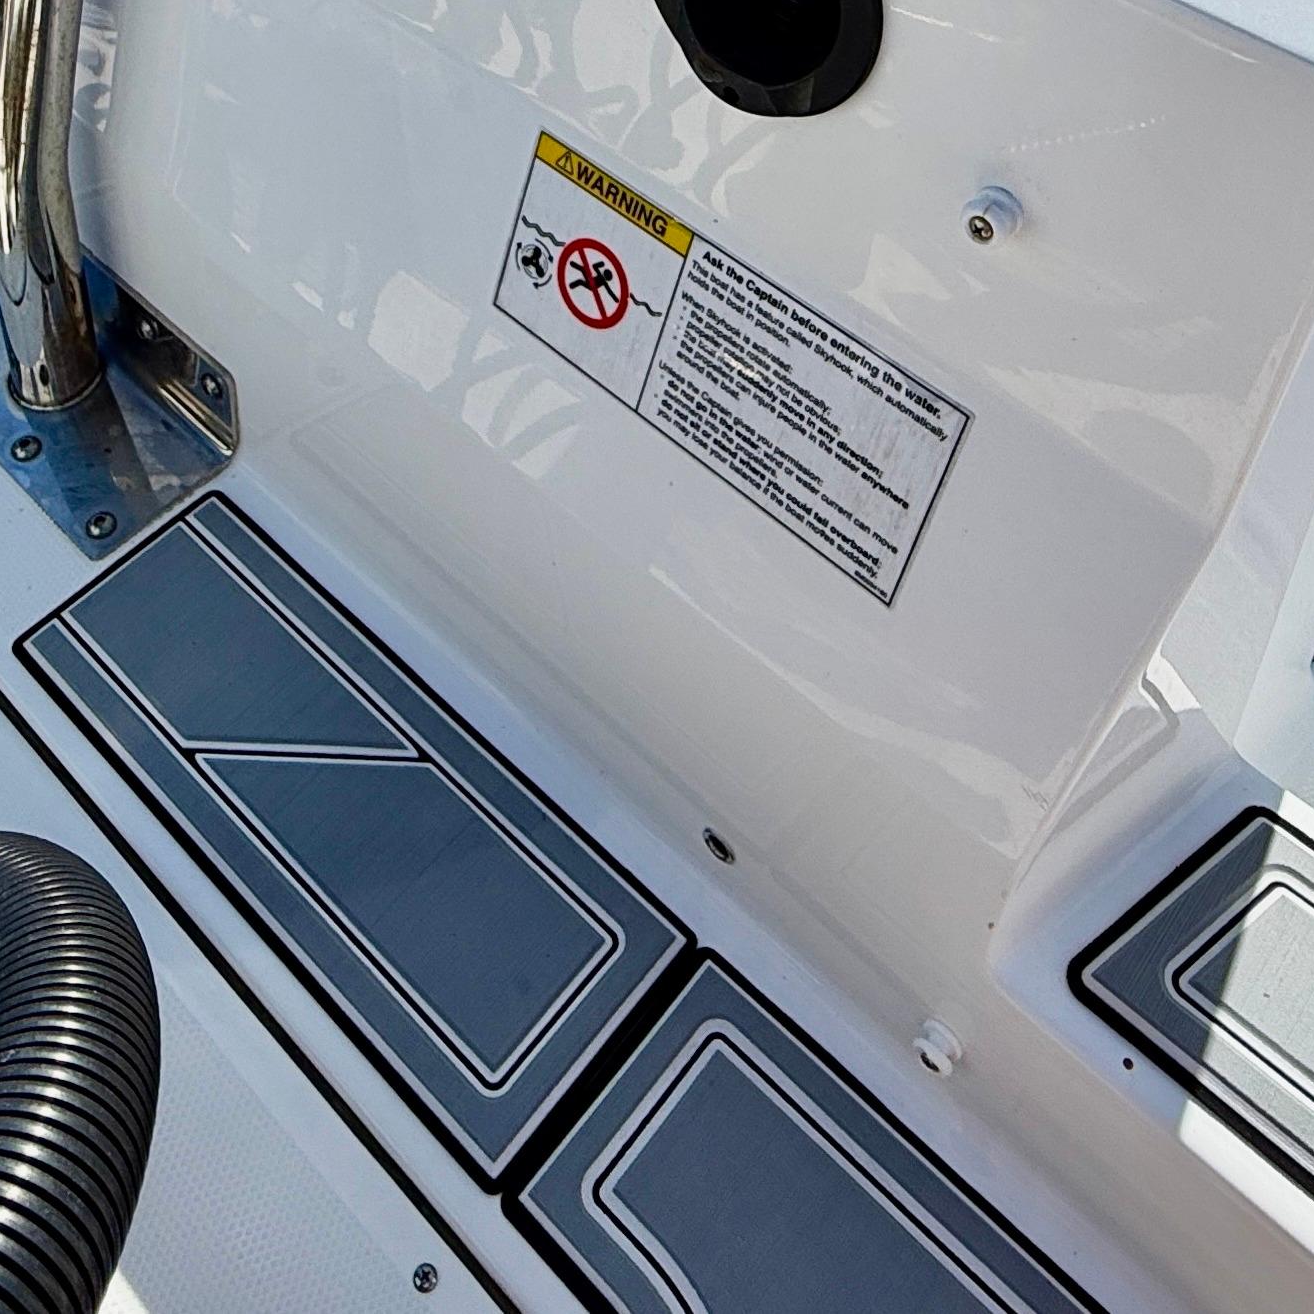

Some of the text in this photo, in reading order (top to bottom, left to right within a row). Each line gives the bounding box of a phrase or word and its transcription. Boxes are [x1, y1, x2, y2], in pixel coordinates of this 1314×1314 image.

[576, 160, 668, 237] WARNING
[681, 290, 705, 313] When
[705, 307, 741, 338] Skyhook
[742, 334, 750, 345] is
[686, 269, 710, 291] holds
[710, 286, 725, 301] the
[725, 296, 745, 315] boat
[745, 310, 754, 321] in
[701, 250, 940, 419] Ask the Captain before entering the water.
[675, 350, 705, 374] around
[705, 370, 719, 384] the
[685, 320, 722, 349] propeller
[775, 383, 790, 398] not
[790, 393, 803, 407] be
[690, 309, 704, 324] the
[703, 320, 745, 353] propellers
[745, 350, 771, 371] rotate
[692, 259, 709, 278] This
[709, 272, 729, 292] boat
[729, 285, 746, 303] has
[746, 299, 753, 308] a
[754, 302, 785, 329] feature
[785, 326, 813, 348] called
[856, 374, 884, 397] which
[884, 394, 948, 442] automatically
[658, 359, 685, 385] Unless
[686, 380, 700, 395] the
[700, 390, 732, 419] Captain
[732, 416, 756, 436] gives
[755, 433, 773, 449] you
[663, 389, 703, 422] swimmers
[703, 418, 720, 434] into
[720, 430, 734, 444] the
[679, 339, 909, 510] the propellers can injure people in the water anywhere
[736, 368, 778, 403] suddenly
[778, 399, 805, 421] move
[805, 416, 816, 429] in
[816, 426, 835, 444] any
[656, 407, 672, 422] you
[672, 419, 690, 437] may
[691, 432, 709, 450] lose
[708, 446, 728, 463] your
[728, 460, 762, 490] balance
[762, 486, 770, 495] if
[769, 491, 784, 507] the
[784, 502, 805, 523] boat
[805, 519, 835, 545] moves
[660, 398, 673, 411] do
[672, 407, 689, 423] not
[688, 419, 701, 432] sit
[700, 429, 712, 439] or
[712, 437, 738, 460] stand
[738, 456, 766, 481] where
[765, 478, 785, 495] you
[785, 492, 813, 516] could
[812, 511, 829, 527] fall
[666, 379, 679, 391] do
[679, 388, 695, 404] not
[695, 400, 708, 413] go
[708, 408, 718, 420] in
[718, 416, 734, 432] the
[762, 450, 784, 469] wind
[783, 466, 794, 476] or
[794, 473, 820, 495] water
[820, 493, 853, 521] current
[853, 517, 871, 534] can
[871, 531, 898, 554] move
